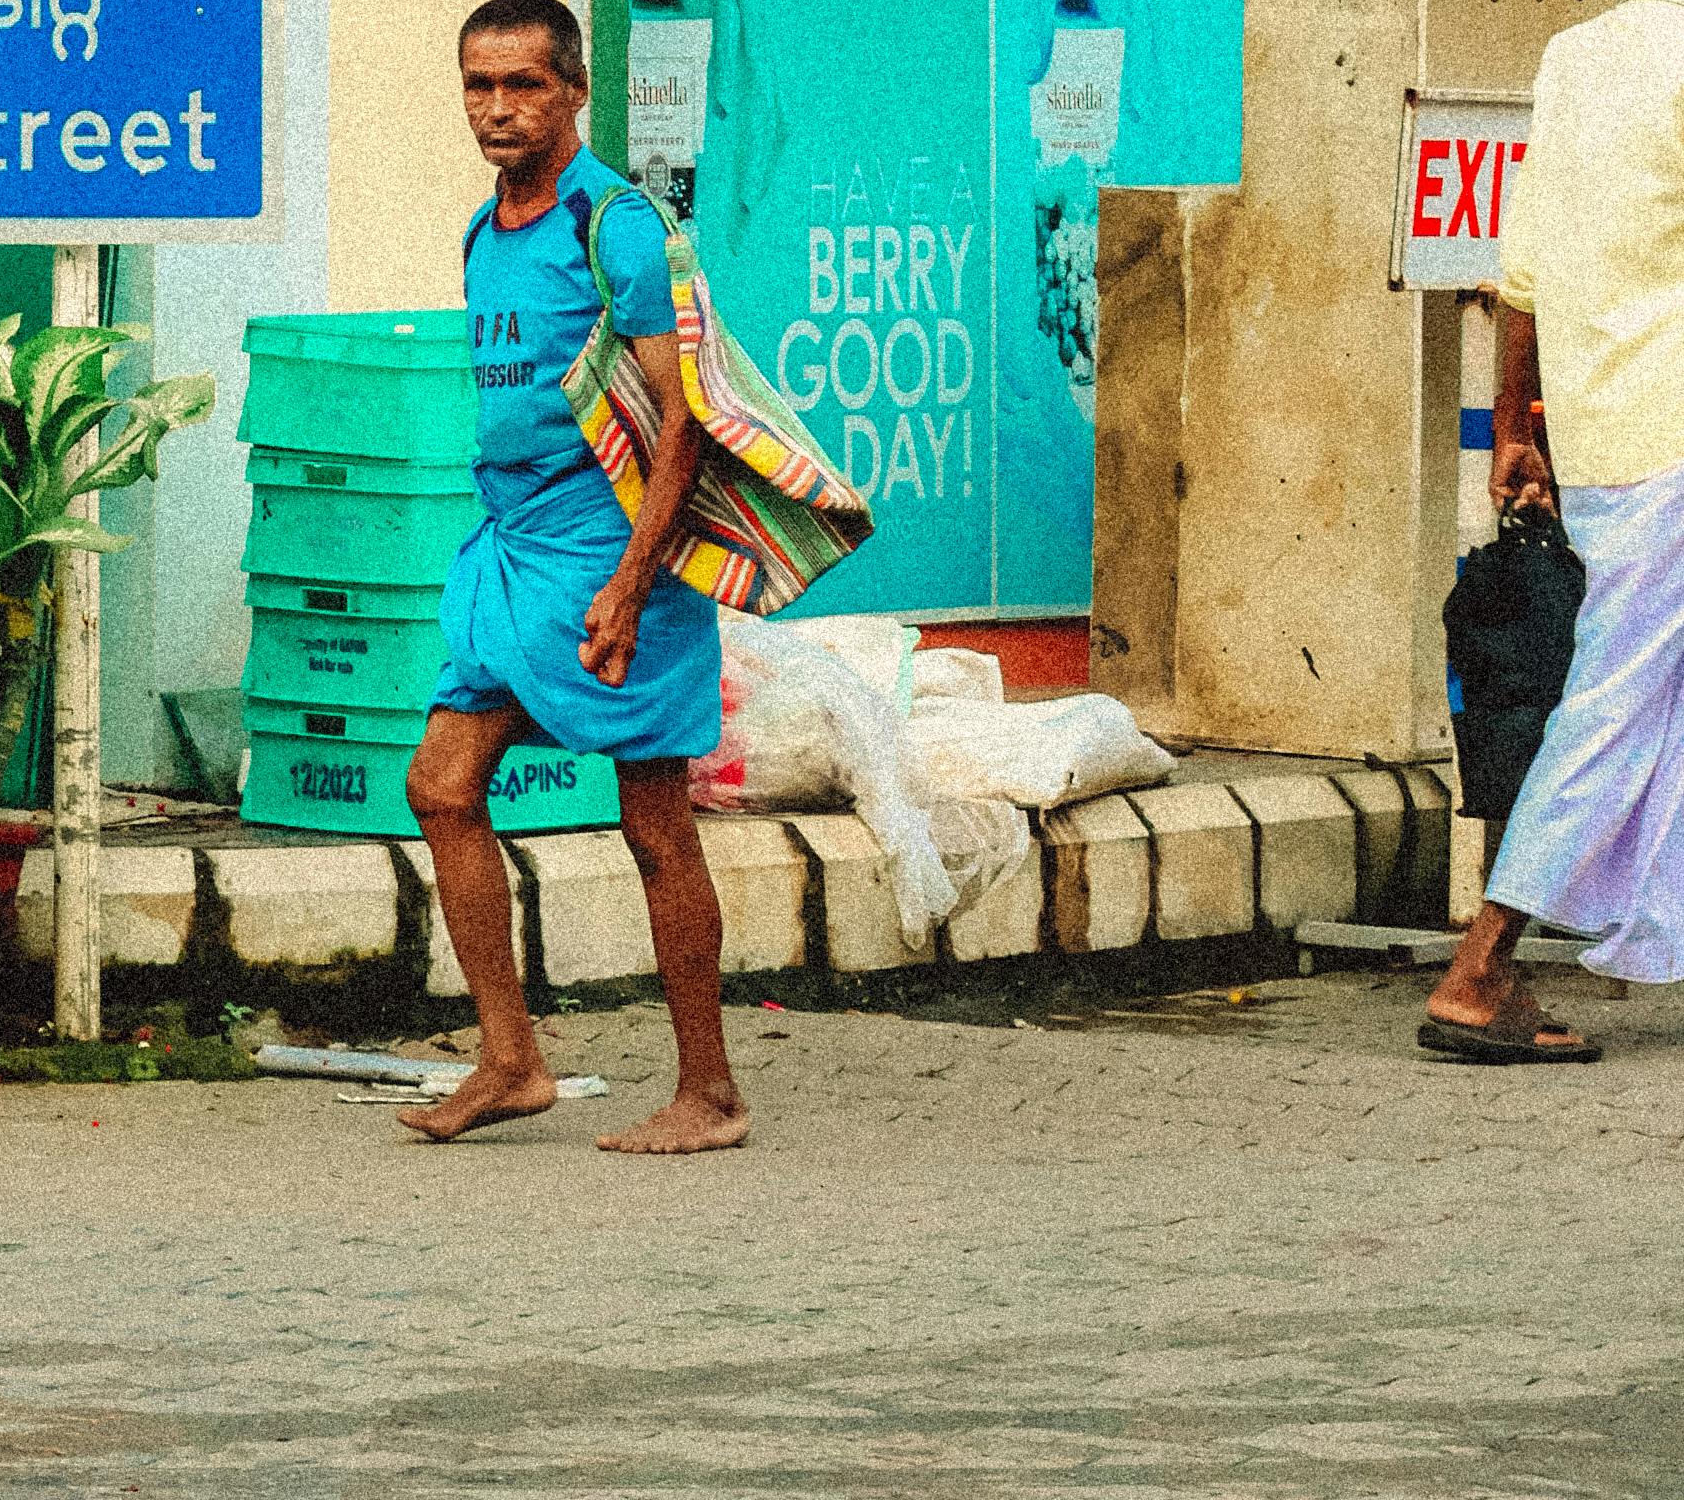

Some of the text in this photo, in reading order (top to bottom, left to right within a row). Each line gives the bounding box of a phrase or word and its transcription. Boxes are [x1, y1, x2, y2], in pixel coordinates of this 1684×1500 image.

[1047, 83, 1103, 110] skinella
[810, 155, 979, 221] HAVE A
[1412, 140, 1528, 238] EXI
[809, 224, 975, 315] BERRY
[777, 318, 974, 414] GOOD
[843, 410, 974, 500] DAY!
[290, 760, 367, 804] 12/2023
[488, 760, 577, 802] SAPINS
